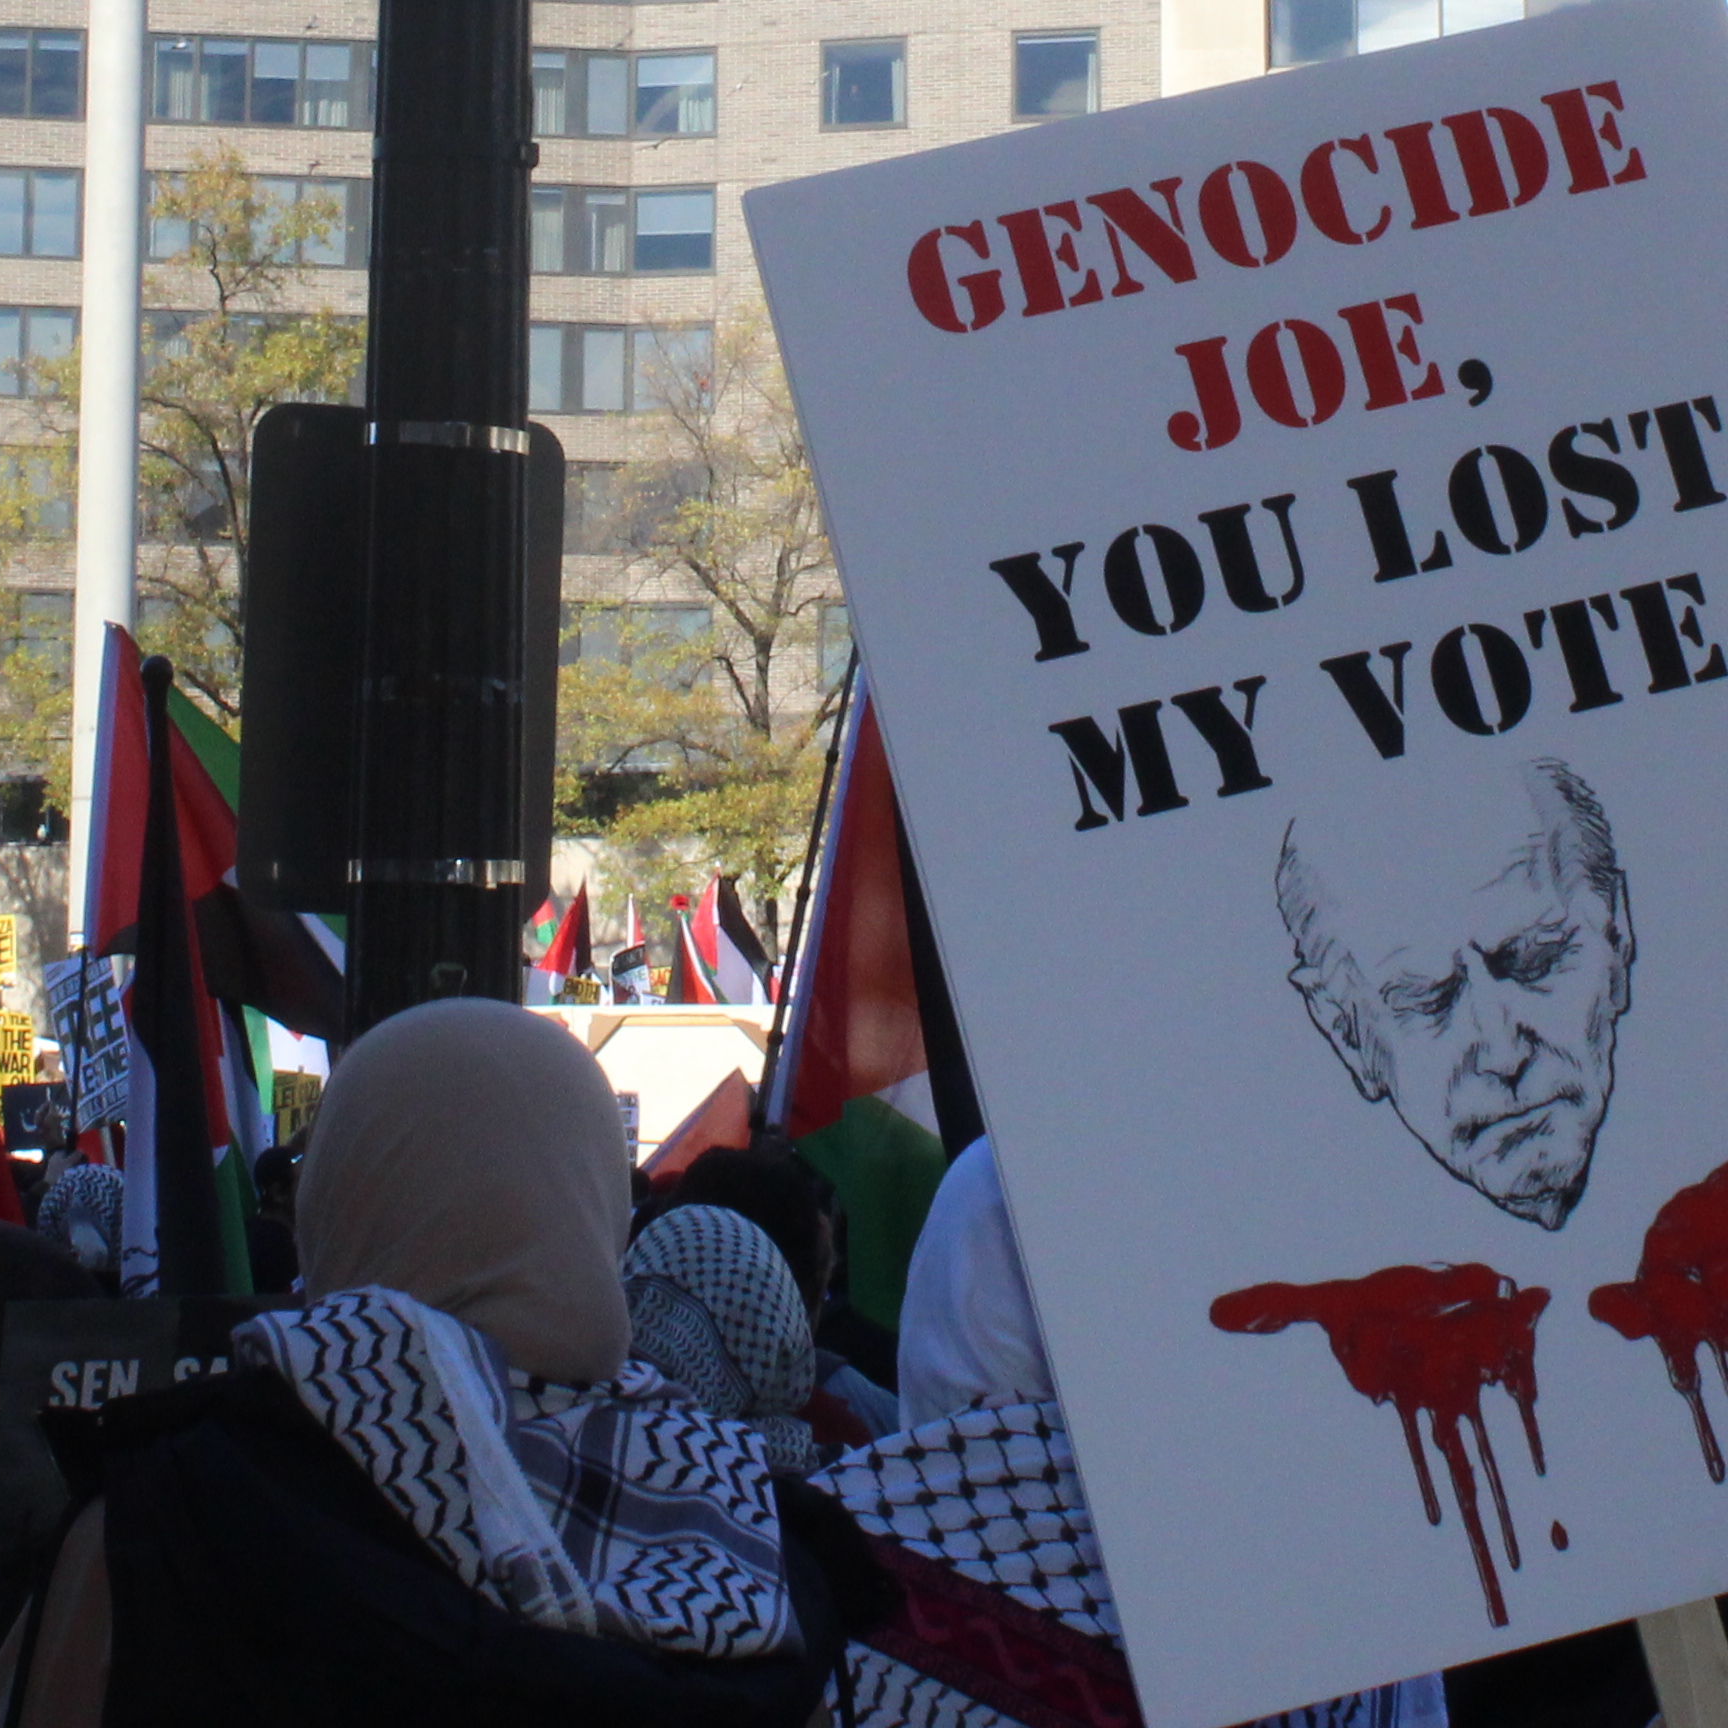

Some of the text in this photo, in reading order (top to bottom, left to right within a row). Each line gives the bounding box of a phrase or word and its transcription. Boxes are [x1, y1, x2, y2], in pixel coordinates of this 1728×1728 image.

[906, 80, 1648, 333] GENOCIDE
[1165, 291, 1494, 452] JOE,
[989, 491, 1306, 661] YOU
[1047, 674, 1274, 832] MY
[3, 1029, 32, 1051] THE
[49, 1359, 140, 1411] SEN
